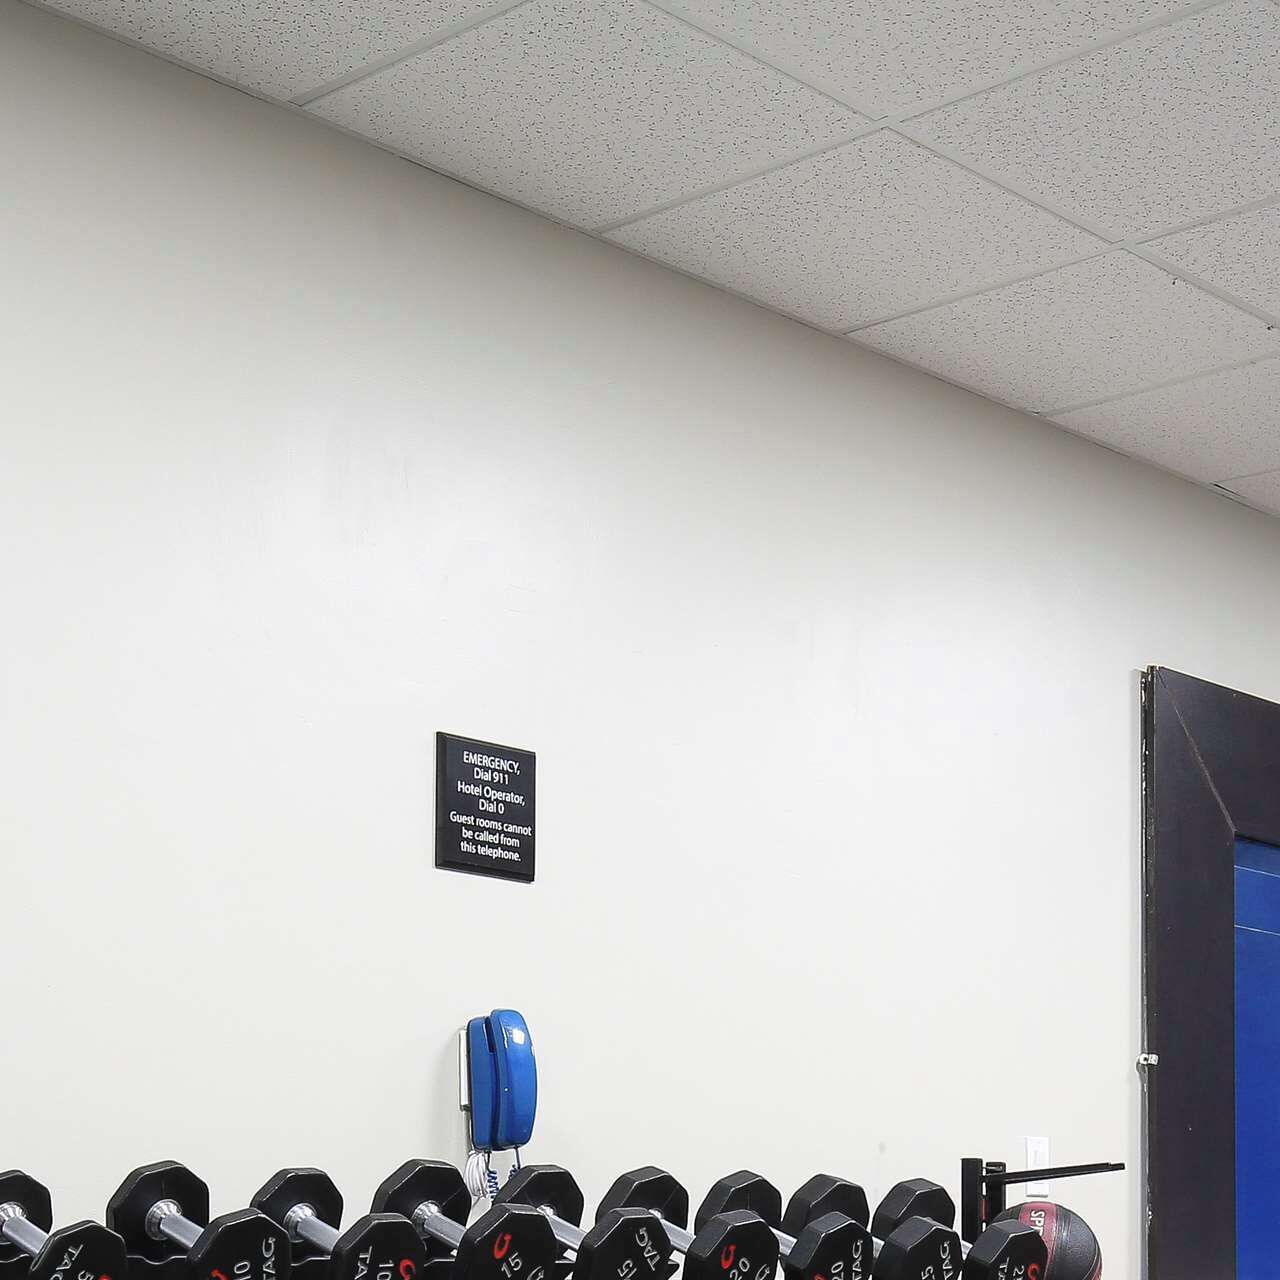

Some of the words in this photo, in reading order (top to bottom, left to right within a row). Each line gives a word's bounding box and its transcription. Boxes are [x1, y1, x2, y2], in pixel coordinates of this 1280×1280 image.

[463, 751, 520, 775] EMERGENCY,
[474, 768, 492, 782] Dial
[493, 771, 509, 785] 911
[457, 781, 482, 797] Hotel
[483, 786, 525, 806] Operator,
[479, 799, 497, 813] Dial
[498, 803, 504, 814] 0
[450, 811, 474, 825] Guest
[476, 818, 502, 831] rooms
[503, 822, 532, 836] cannot
[462, 827, 473, 839] be
[474, 829, 499, 845] called
[500, 834, 520, 848] from
[460, 841, 476, 854] this
[477, 844, 521, 862] telephone.
[636, 1227, 661, 1271] TAG
[501, 1251, 522, 1278] 15
